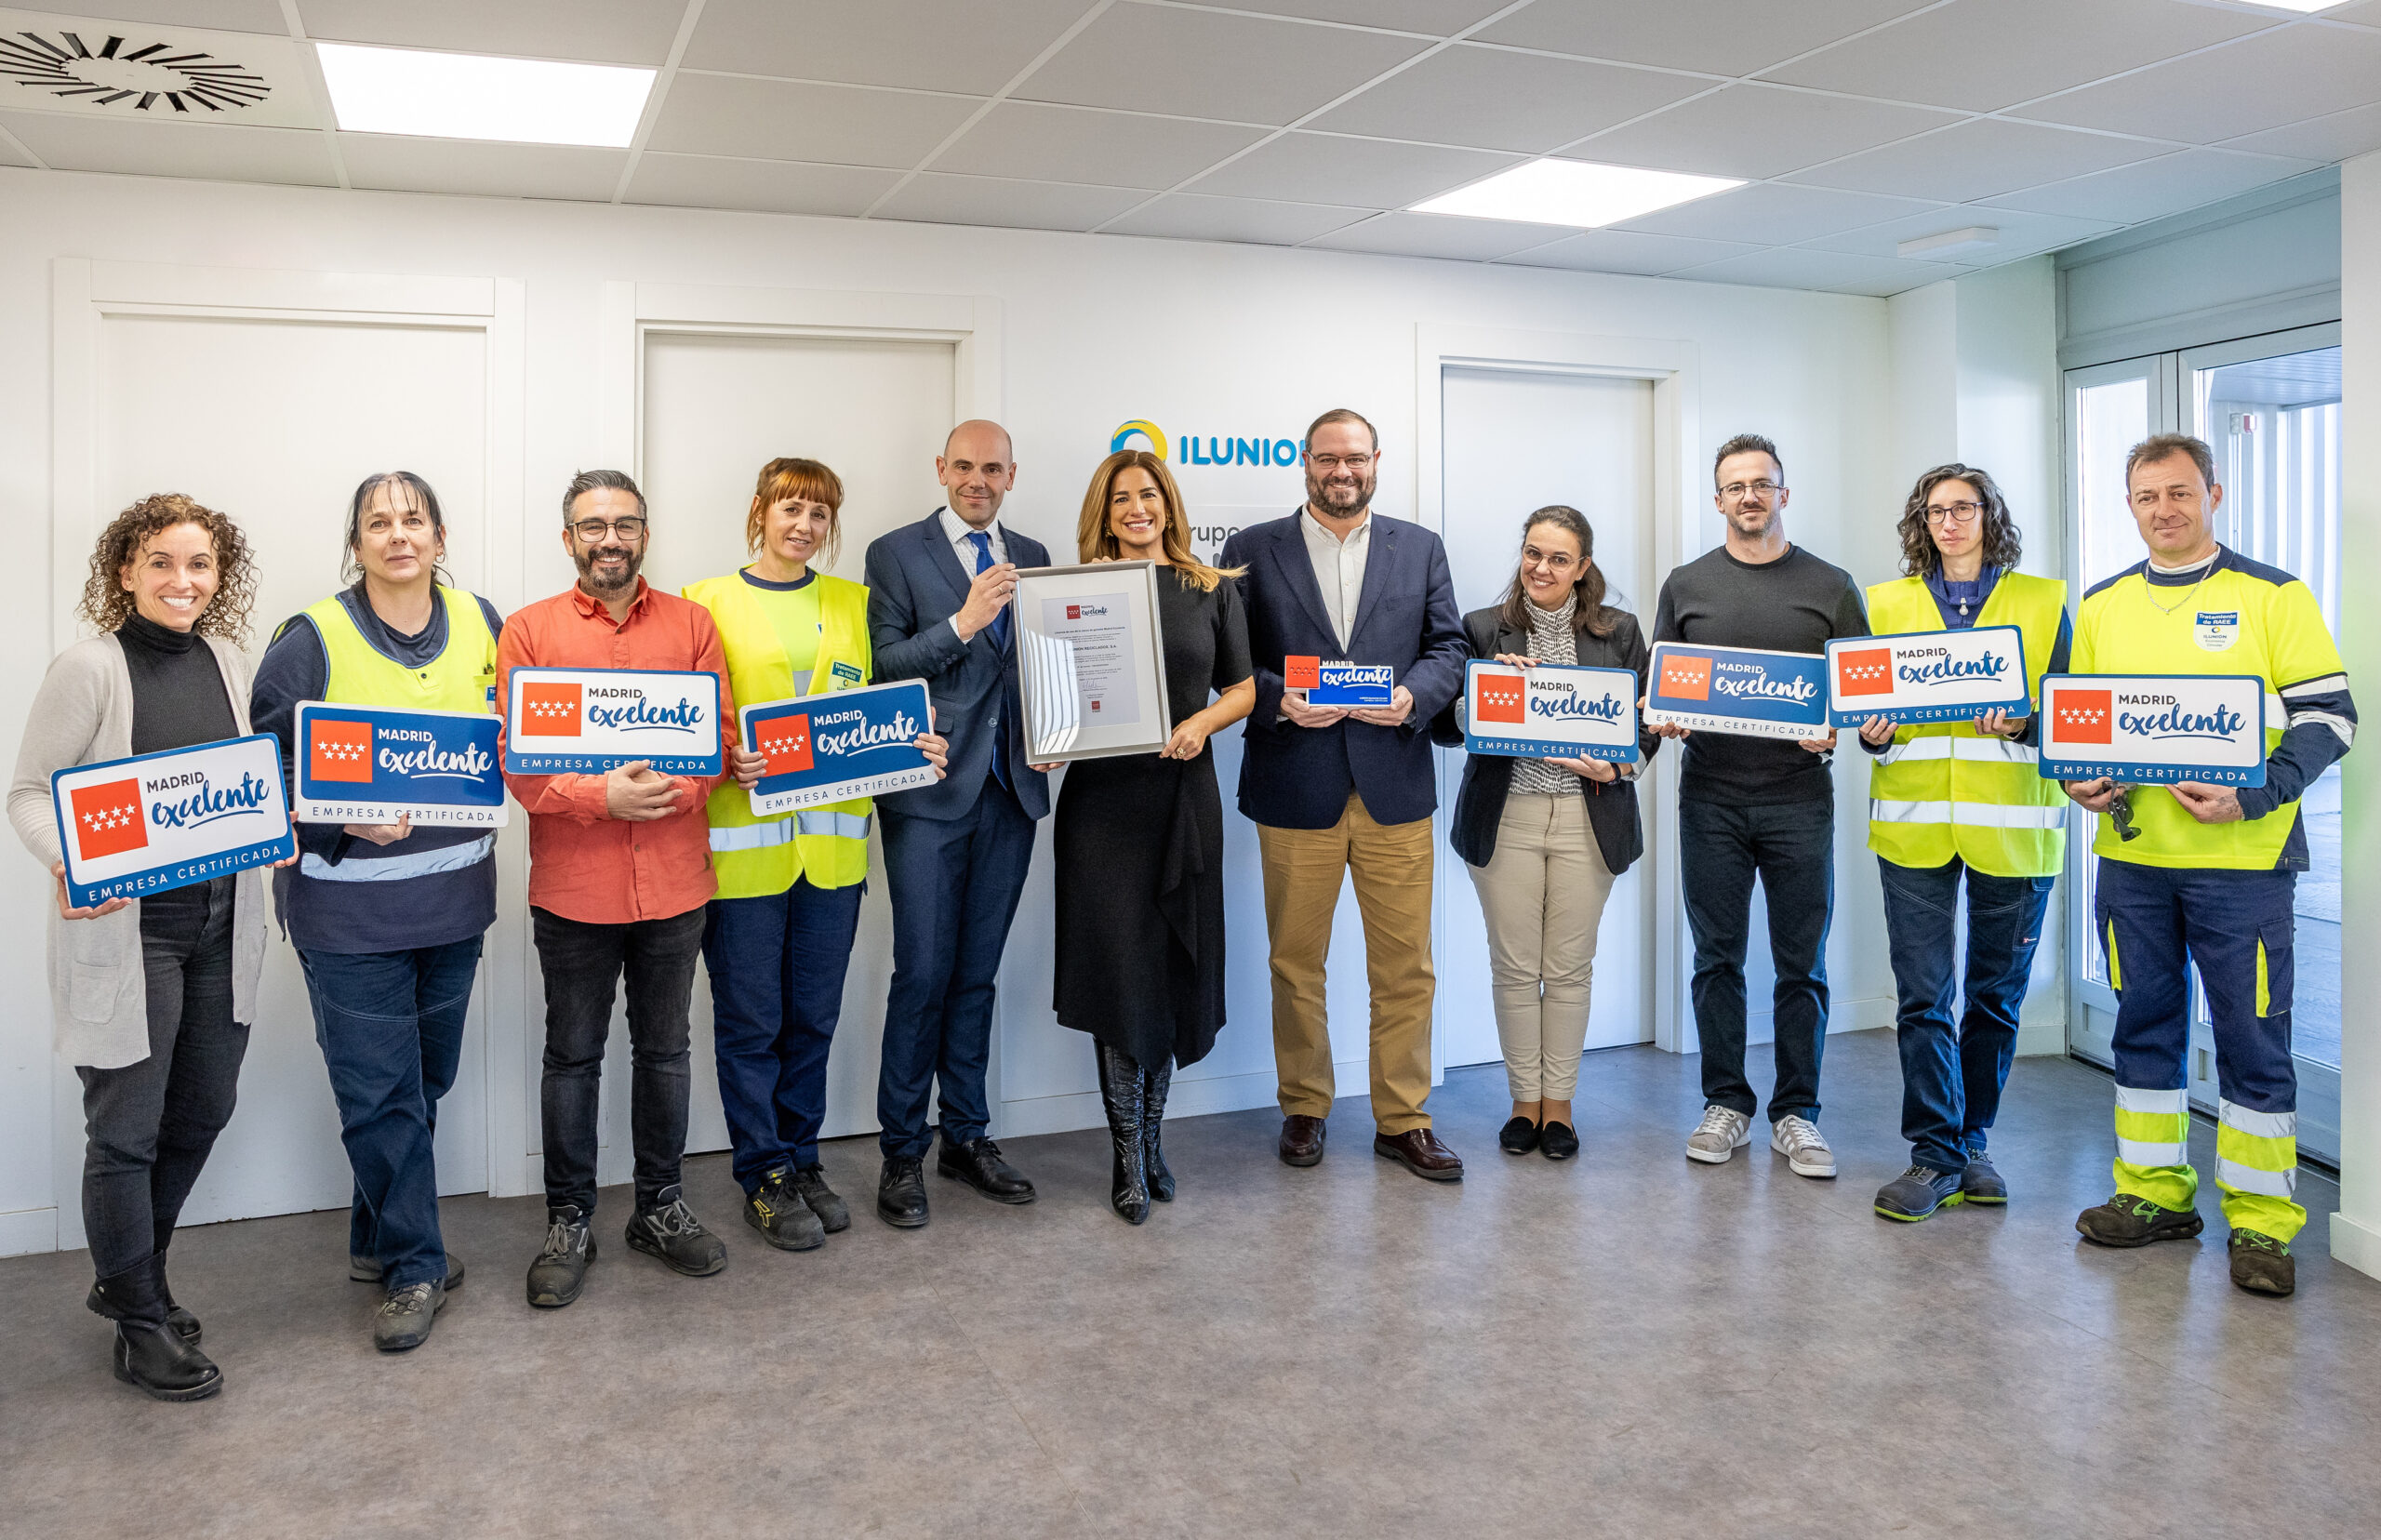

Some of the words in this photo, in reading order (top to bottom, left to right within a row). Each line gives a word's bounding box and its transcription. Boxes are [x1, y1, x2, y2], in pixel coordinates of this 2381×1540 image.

[1180, 435, 1306, 467] ILUNIO
[1896, 647, 1948, 659] MADRID
[1322, 665, 1392, 685] excelente
[1716, 662, 1764, 674] MADRID
[1899, 650, 2010, 684] excelente
[589, 687, 643, 698] MADRID
[1530, 681, 1574, 692] MADRID
[1714, 672, 1818, 700] excelente
[1530, 690, 1625, 719] excelente
[2119, 695, 2176, 705] MADRID
[588, 697, 705, 728] excelente
[814, 710, 863, 727] MADRID
[1842, 712, 1907, 724] EMPESA
[1916, 705, 2015, 719] CERTIFICDA
[2119, 703, 2246, 736] excelente
[379, 728, 432, 742] MADRID
[818, 710, 920, 756] excelente
[1656, 714, 1716, 727] EMPRESA
[1723, 721, 1815, 737] CERTIFICADA
[1478, 740, 1535, 752] EMPRESA
[379, 740, 493, 776] excelente
[521, 759, 593, 768] EMPRESA
[603, 760, 706, 770] CEFICADA
[146, 771, 205, 793] MADRID
[2054, 764, 2125, 777] EMPRESA
[2135, 768, 2248, 781] CERTIFICADA
[152, 771, 270, 829] excelente
[765, 790, 829, 810] EMPRESA
[837, 773, 926, 797] CERTIFICADA
[313, 806, 385, 818] EMPRESA
[88, 873, 168, 902] EMPRESA
[177, 845, 281, 880] CERTIFICADA
